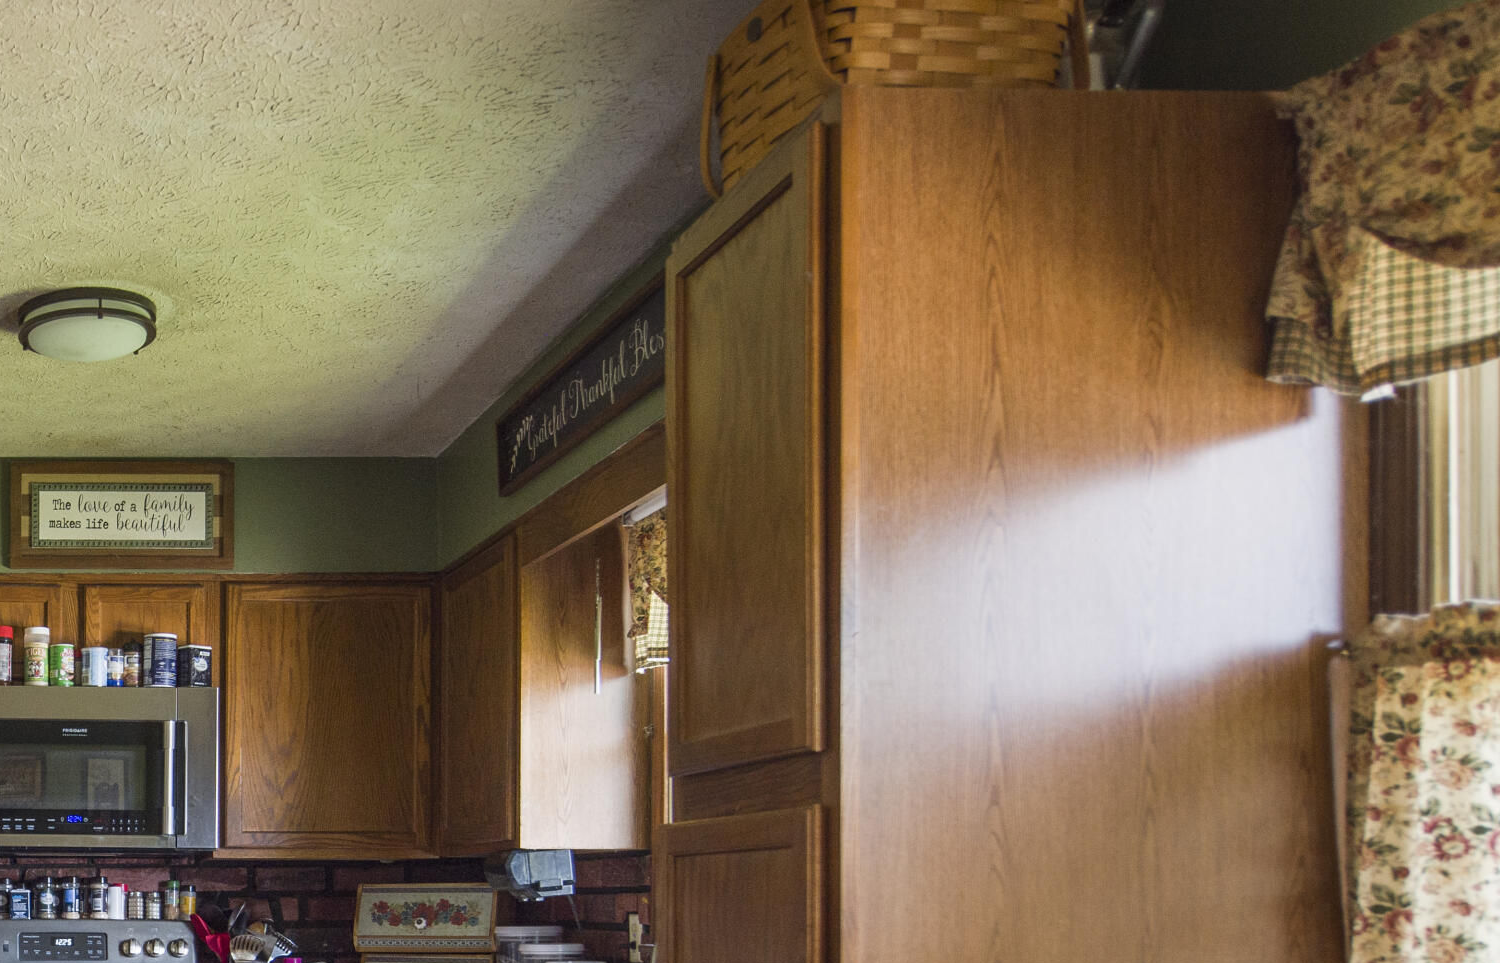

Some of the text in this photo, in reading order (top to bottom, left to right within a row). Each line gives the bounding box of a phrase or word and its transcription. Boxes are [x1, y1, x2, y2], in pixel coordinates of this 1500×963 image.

[526, 318, 665, 460] Grateful Thankful Bles
[52, 494, 194, 519] The love of a family
[49, 513, 186, 536] makes life beautiful
